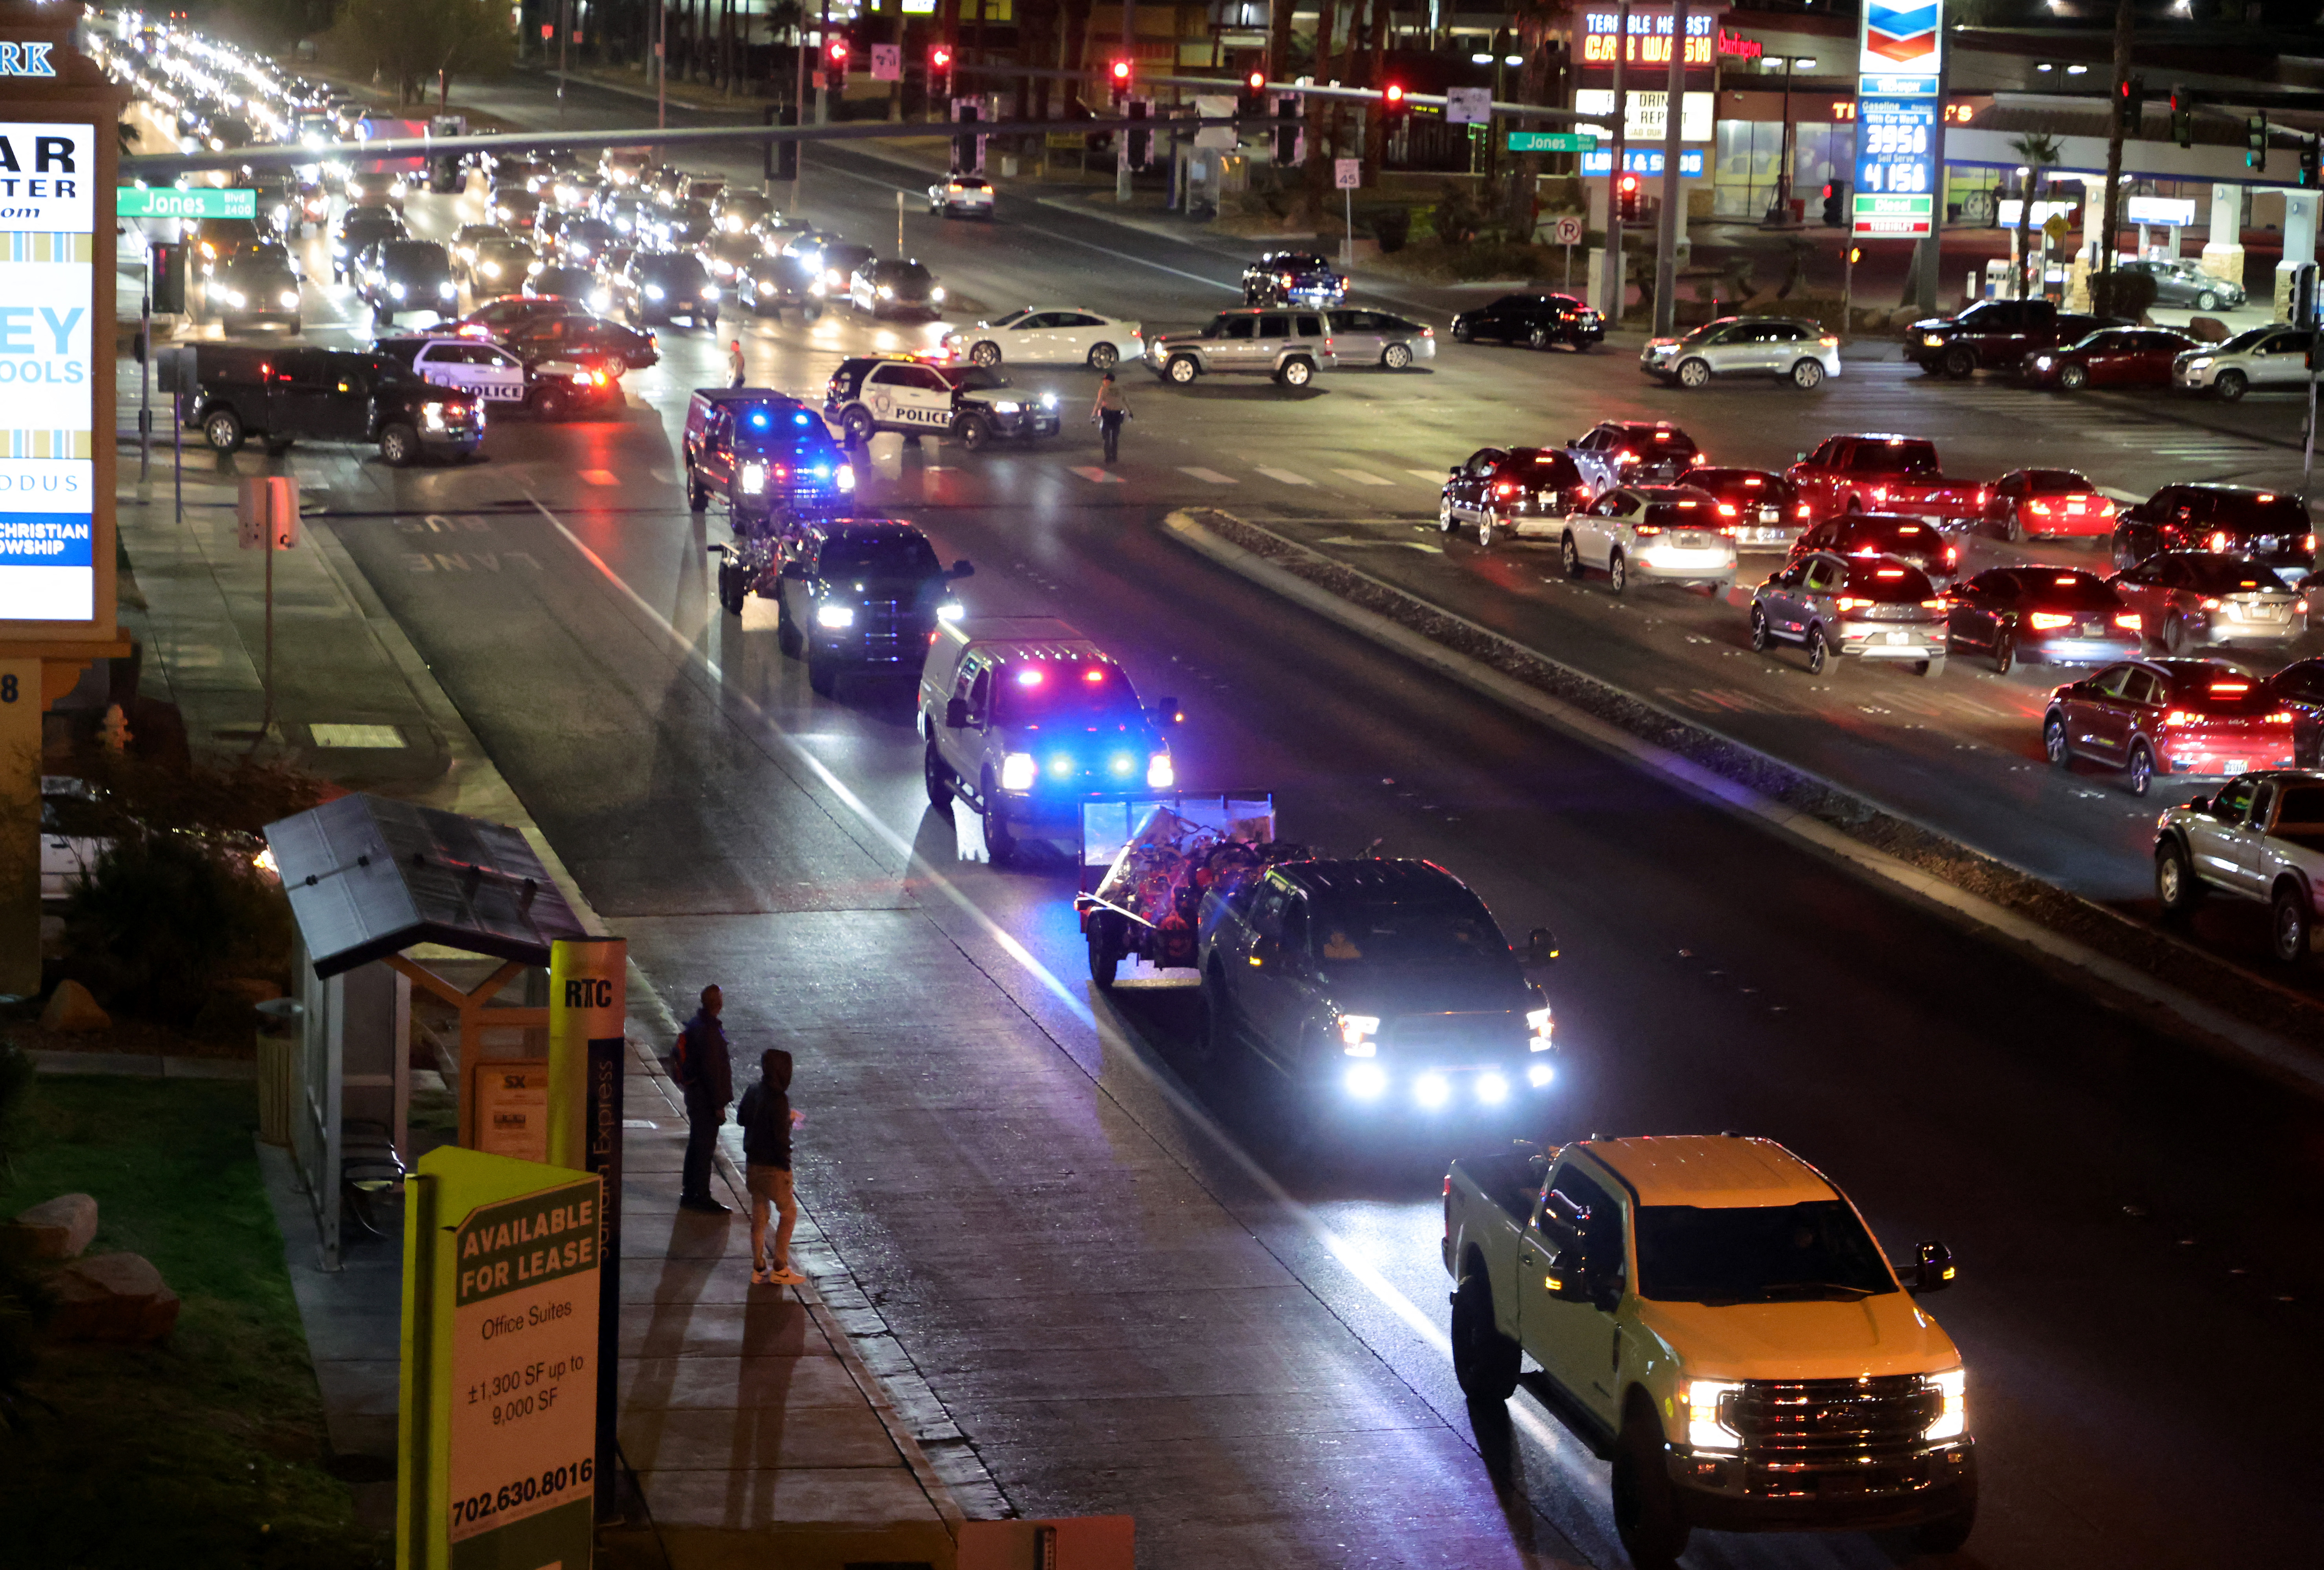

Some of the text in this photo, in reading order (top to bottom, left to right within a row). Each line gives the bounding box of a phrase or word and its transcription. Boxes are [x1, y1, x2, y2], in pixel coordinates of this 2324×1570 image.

[1656, 15, 1712, 36] HEBST
[1862, 101, 1900, 111] Gasoline
[1866, 114, 1884, 124] With
[1884, 115, 1898, 124] Car
[1899, 115, 1919, 124] Wash
[1527, 135, 1566, 150] Jones
[1633, 153, 1647, 171] &
[0, 179, 75, 197] TER
[1340, 174, 1357, 185] 45
[142, 192, 205, 214] Jones
[224, 192, 245, 203] Blvd
[1875, 199, 1911, 212] Diesel
[1, 208, 40, 218] om
[224, 204, 252, 215] 2400
[0, 307, 85, 355] EY
[0, 360, 83, 383] OOLS
[896, 408, 947, 424] POLICE
[1, 674, 18, 703] 8
[565, 979, 612, 1008] RTC
[593, 1061, 615, 1154] Express
[463, 1200, 592, 1258] AVAILABLE
[462, 1237, 592, 1297] FOR LEASE
[482, 1301, 572, 1340] Office Suites
[468, 1356, 584, 1404] ±1,300 SF up to
[493, 1387, 558, 1426] 9,000 SF
[453, 1458, 593, 1526] 702.630.8016
